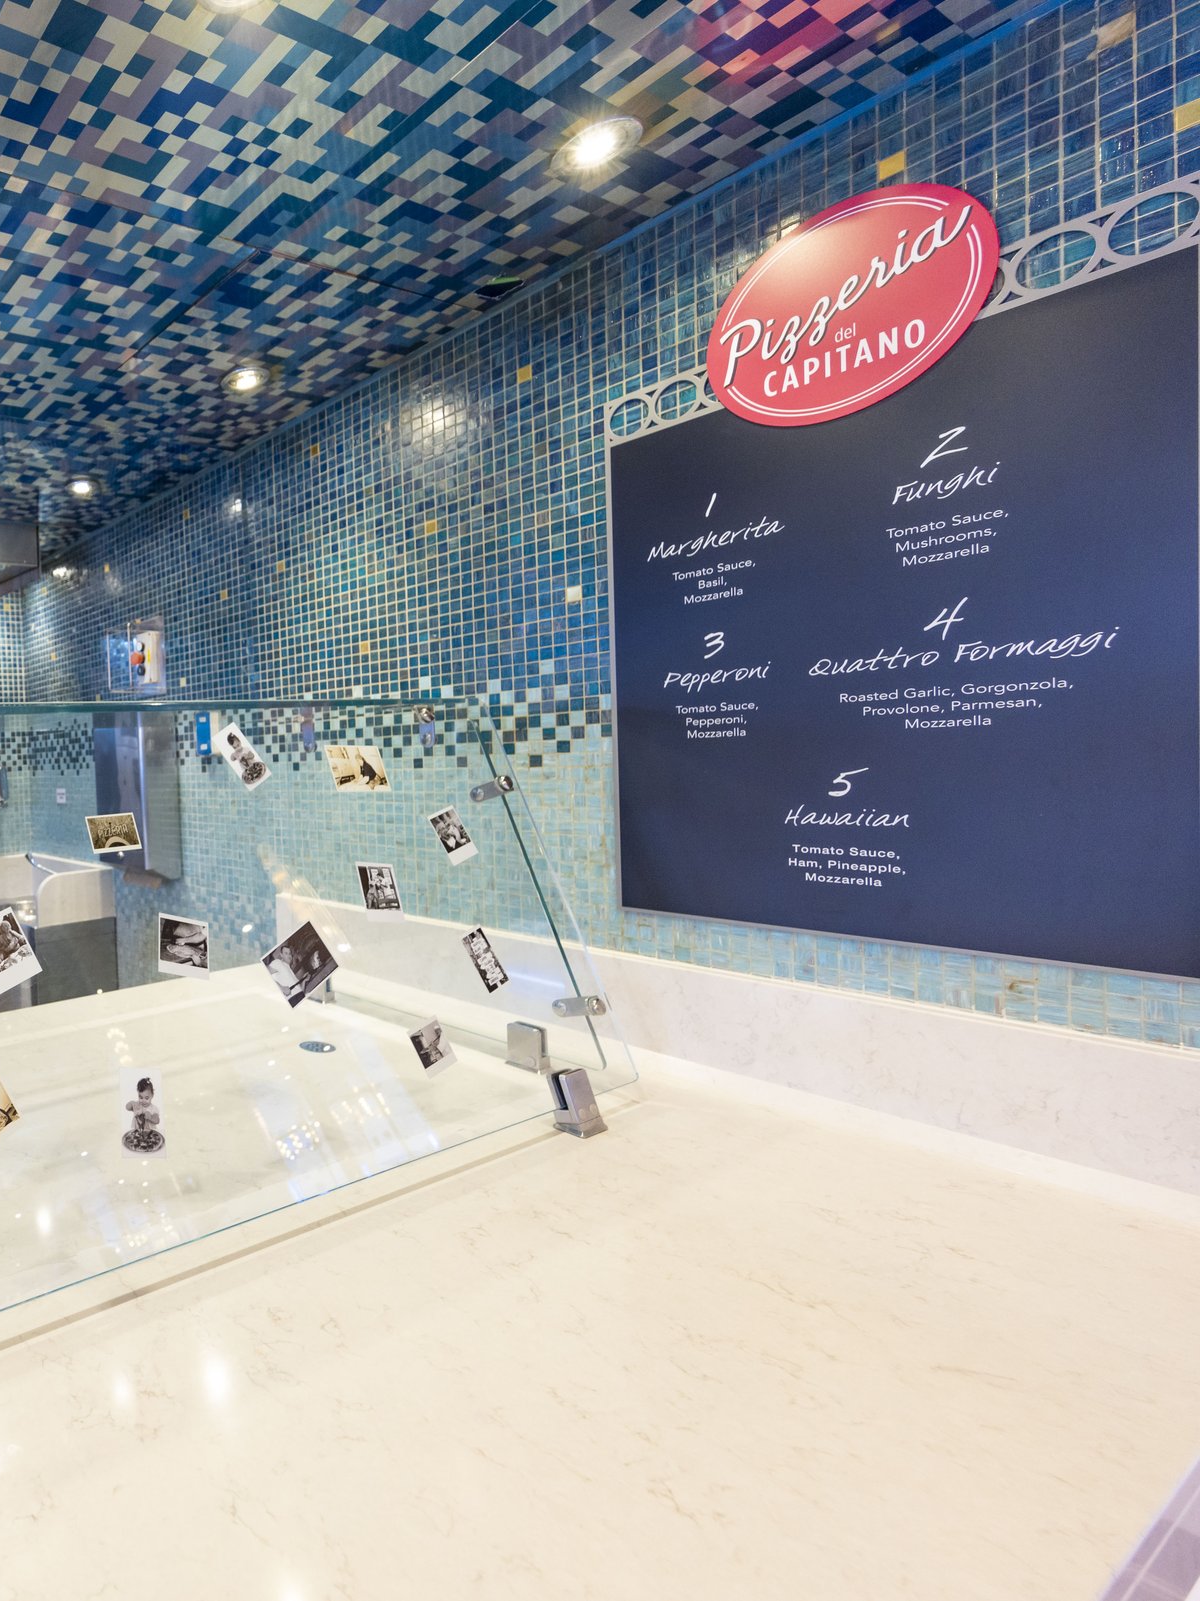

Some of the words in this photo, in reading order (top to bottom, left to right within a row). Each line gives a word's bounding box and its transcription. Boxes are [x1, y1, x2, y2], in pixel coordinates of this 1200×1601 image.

[719, 204, 973, 388] Pizzeria
[834, 322, 857, 343] del
[763, 318, 926, 398] CAPITANO
[919, 425, 969, 469] 2
[891, 461, 1001, 505] Funghi
[885, 520, 946, 539] Tomato
[951, 508, 1009, 527] Sauce,
[647, 515, 785, 562] Margherita
[894, 527, 997, 553] Mushrooms,
[902, 543, 990, 567] Mozzarella
[672, 567, 714, 581] Tomato
[716, 559, 756, 573] Sauce,
[698, 576, 727, 590] Basil,
[683, 587, 744, 605] Mozzarella
[923, 596, 969, 641] 4
[703, 631, 725, 660] 3
[808, 646, 940, 676] Quattro
[953, 626, 1120, 663] Formaggi
[663, 661, 770, 692] Pepperoni
[839, 688, 899, 703] Roasted
[903, 685, 955, 699] Garlic,
[960, 676, 1074, 696] Gorgonzola,
[675, 704, 717, 714] Tomato
[720, 701, 759, 712] Sauce,
[862, 703, 945, 716] Provolone,
[951, 698, 1042, 712] Parmesan,
[685, 714, 747, 728] Pepperoni,
[687, 727, 747, 739] Mozzarella
[905, 714, 992, 729] Mozzarella
[827, 767, 870, 797] 5
[784, 804, 910, 828] Hawaiian
[791, 843, 845, 856] Tomato
[849, 846, 900, 860] Sauce,
[788, 857, 823, 870] Ham,
[827, 859, 906, 876] Pineapple,
[805, 872, 883, 887] Mozzarella
